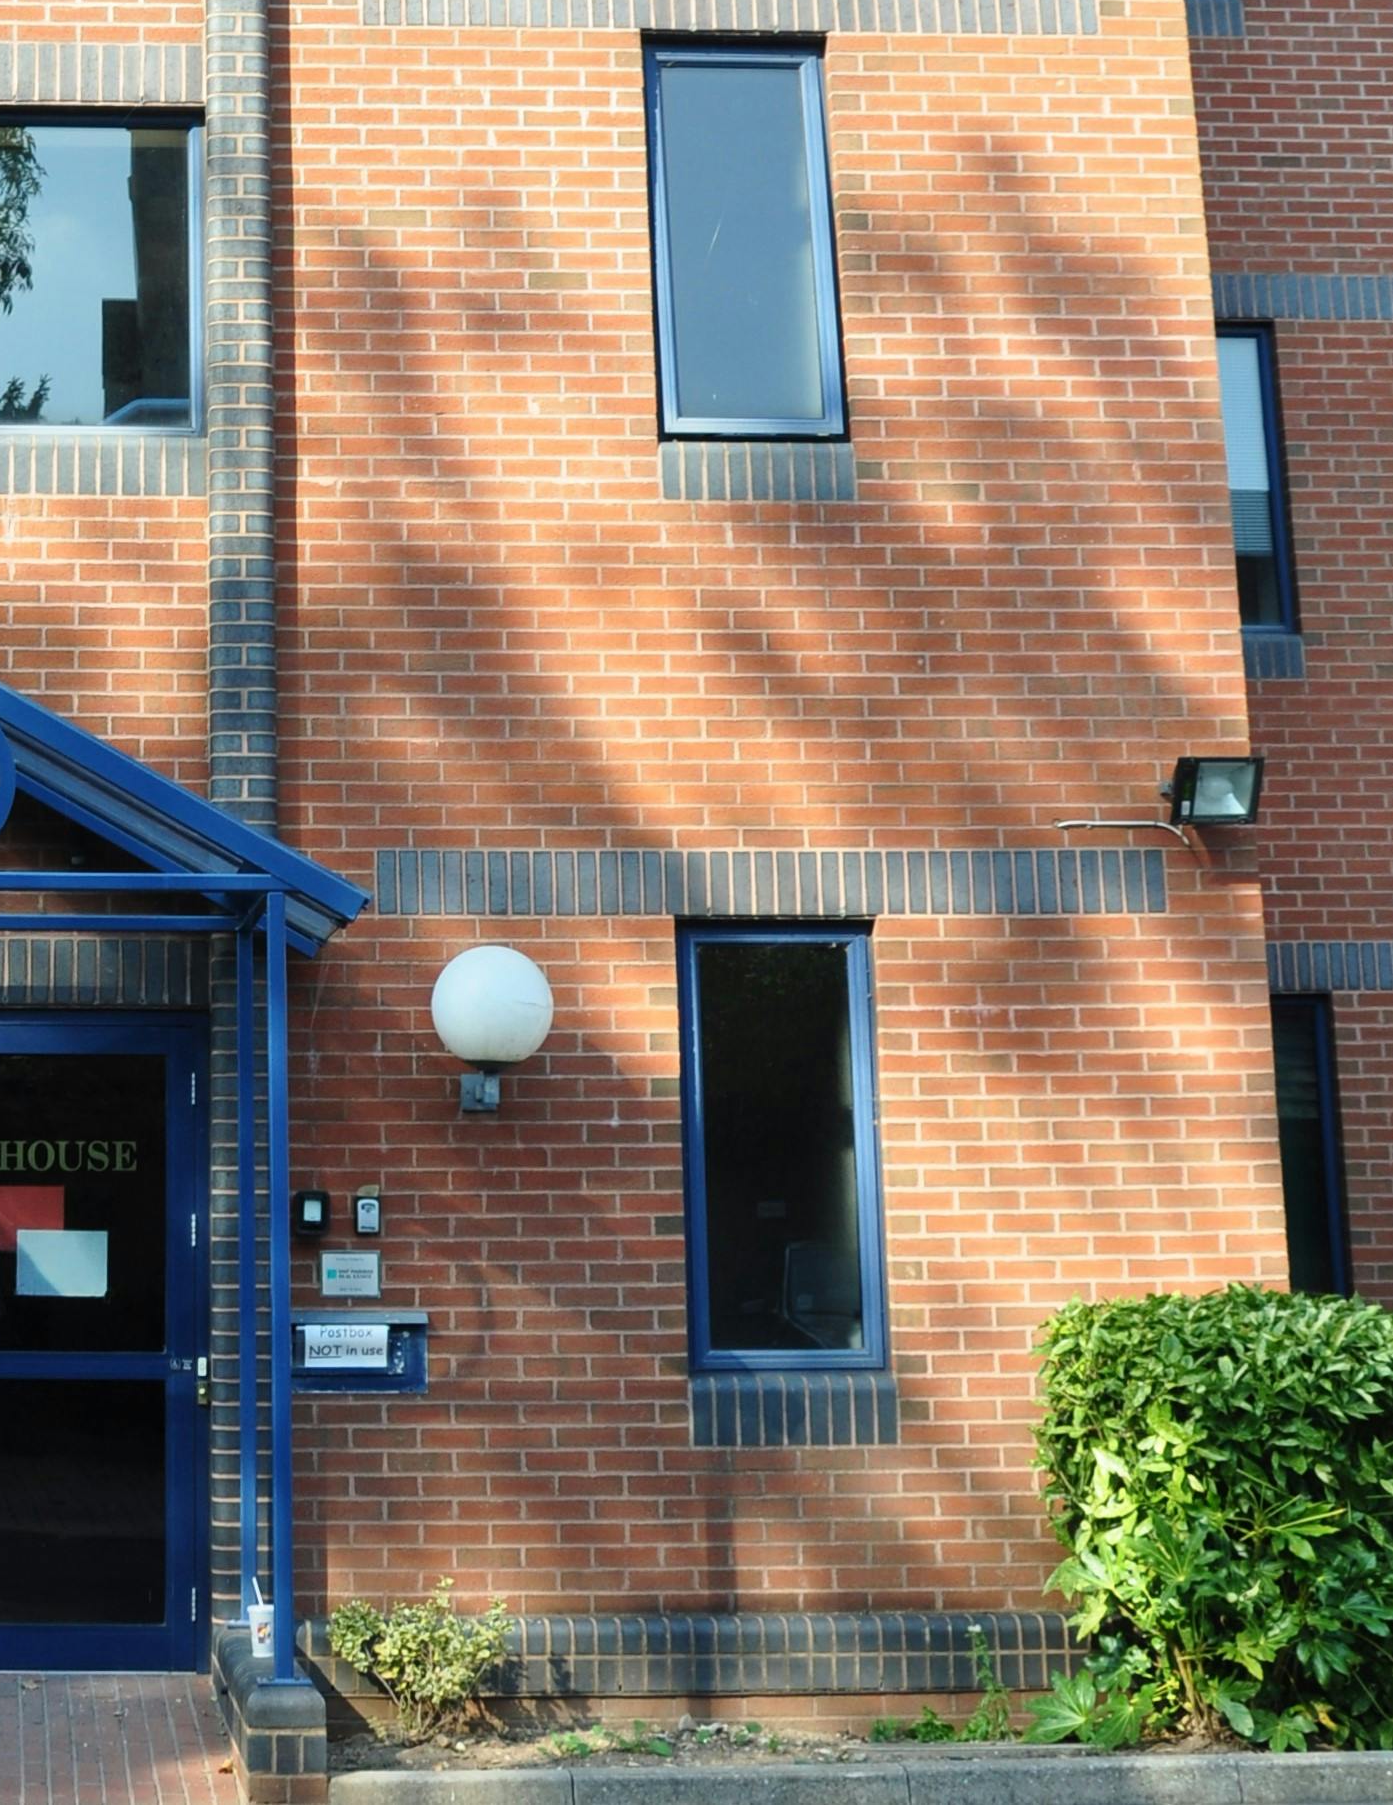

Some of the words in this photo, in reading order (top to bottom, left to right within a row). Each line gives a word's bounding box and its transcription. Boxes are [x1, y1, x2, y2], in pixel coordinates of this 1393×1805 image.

[309, 1345, 342, 1356] NOT
[346, 1345, 357, 1355] in
[362, 1347, 384, 1355] use
